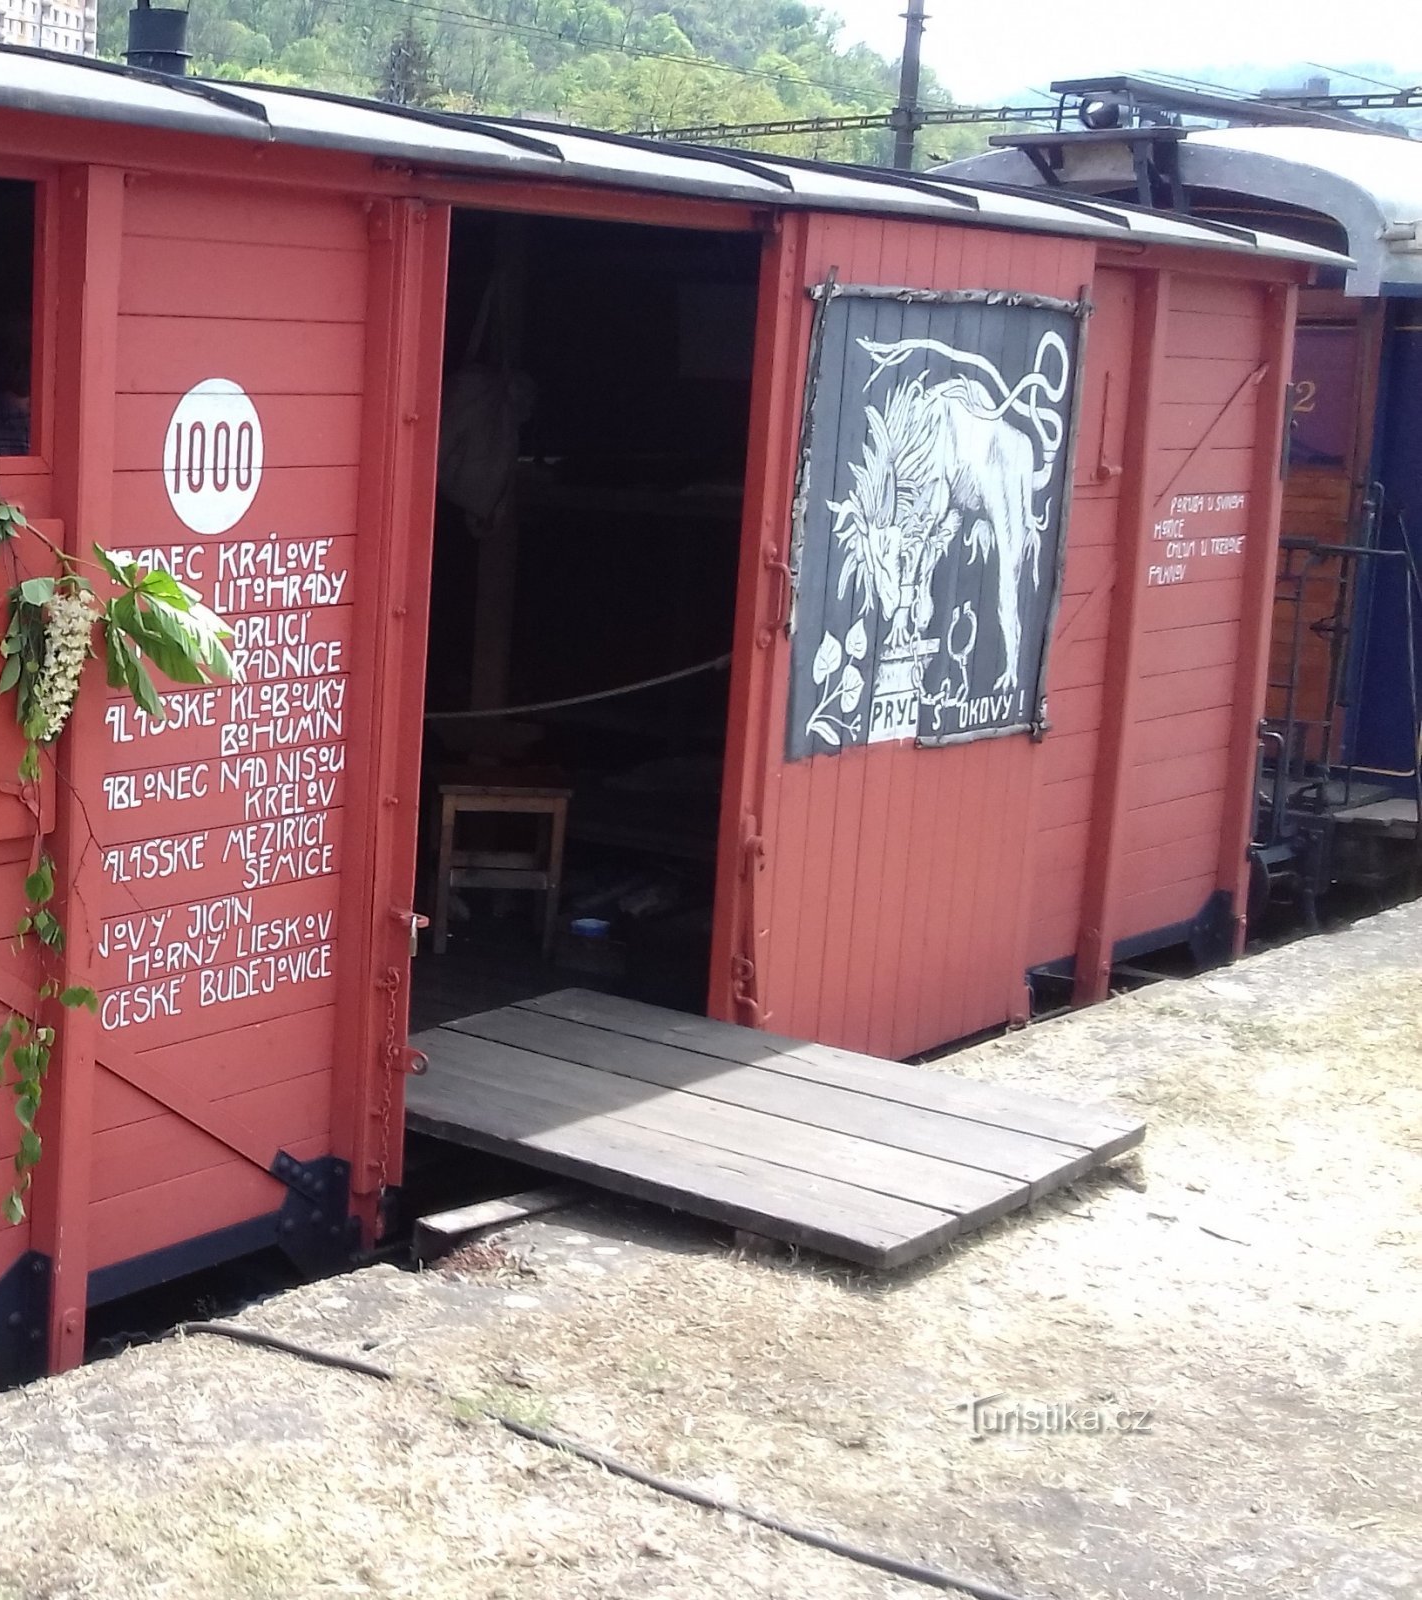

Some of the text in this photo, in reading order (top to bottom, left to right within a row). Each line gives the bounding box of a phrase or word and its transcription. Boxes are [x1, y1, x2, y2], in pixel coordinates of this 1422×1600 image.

[174, 421, 253, 494] 1000
[214, 569, 347, 613] LITOHRADY
[231, 679, 346, 721] KLOBOUKY
[220, 756, 268, 793] NAD
[275, 746, 345, 783] NISOU
[242, 844, 334, 889] SEMICE
[236, 909, 333, 958] LIESKOV
